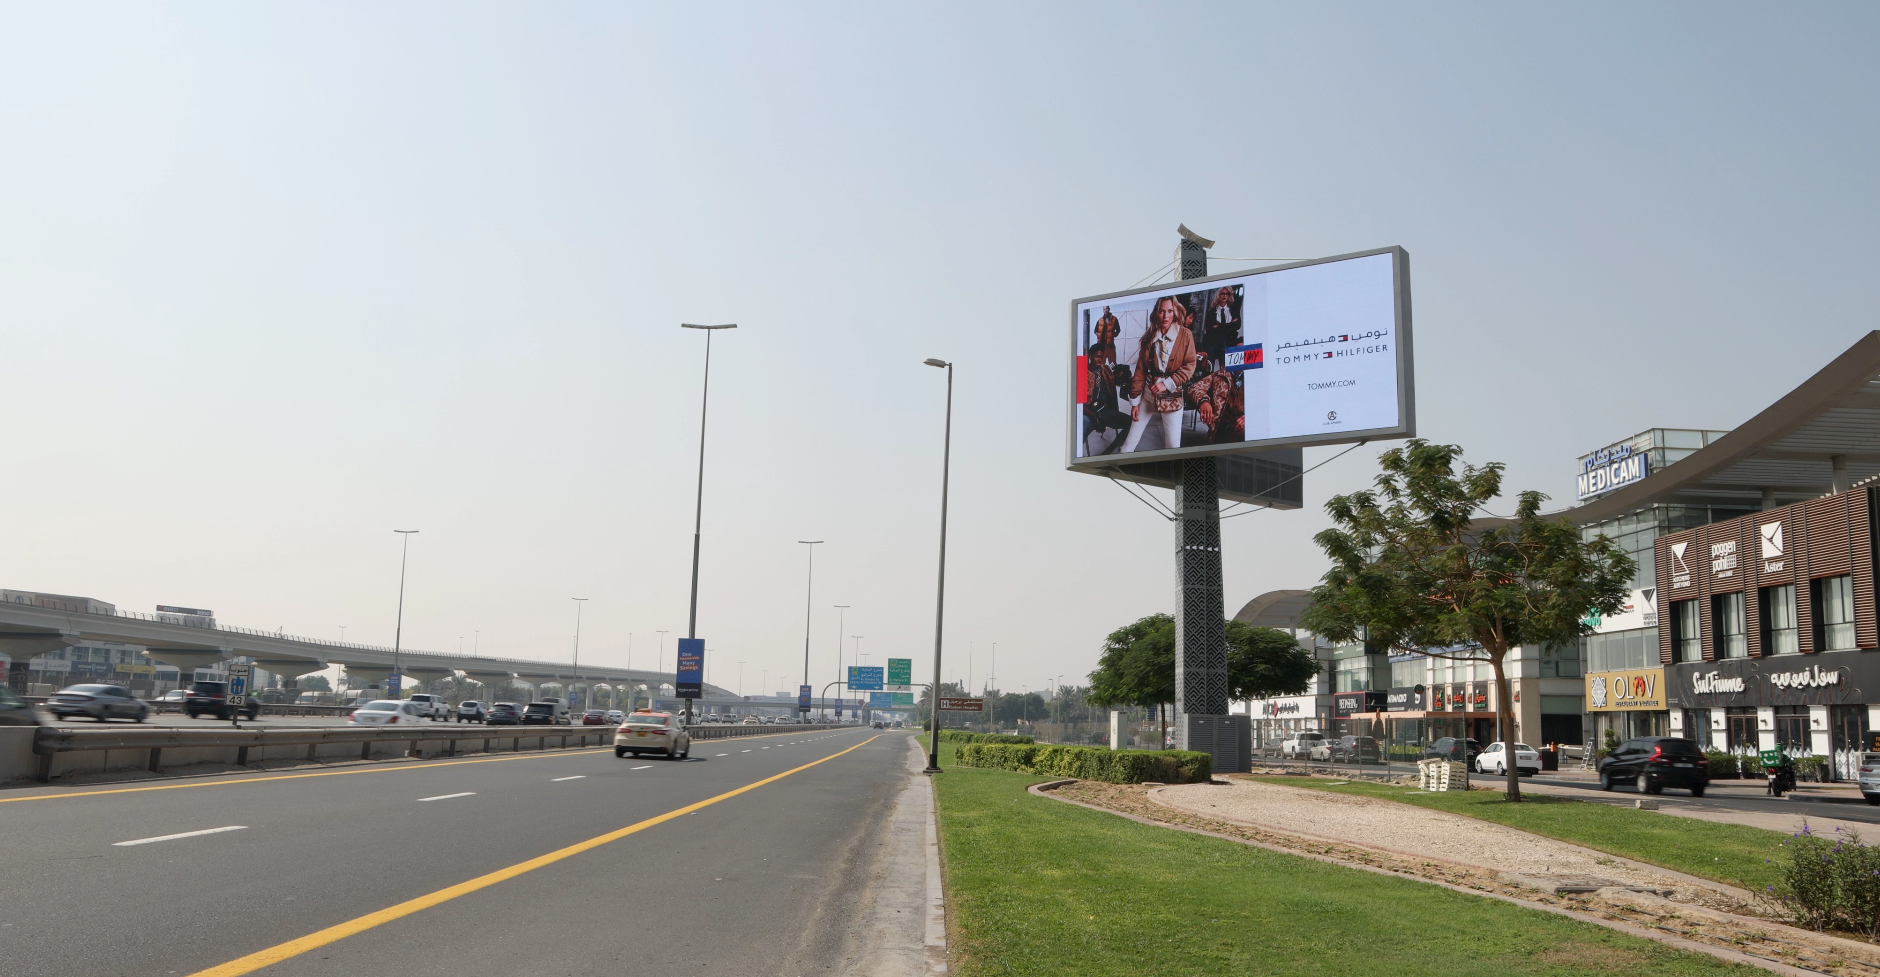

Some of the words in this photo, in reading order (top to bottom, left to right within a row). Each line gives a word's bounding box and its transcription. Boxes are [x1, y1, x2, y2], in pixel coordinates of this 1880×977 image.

[1227, 351, 1260, 365] TOMMY
[1276, 352, 1320, 365] TOMMY
[1337, 344, 1388, 358] HILFIGER
[1307, 379, 1356, 391] TOMMY.COM
[1578, 456, 1640, 496] MEDICAM
[1711, 541, 1736, 559] poggen
[1712, 558, 1727, 575] pohl
[1763, 560, 1785, 574] Aster
[233, 685, 241, 693] 11
[229, 695, 243, 705] 43
